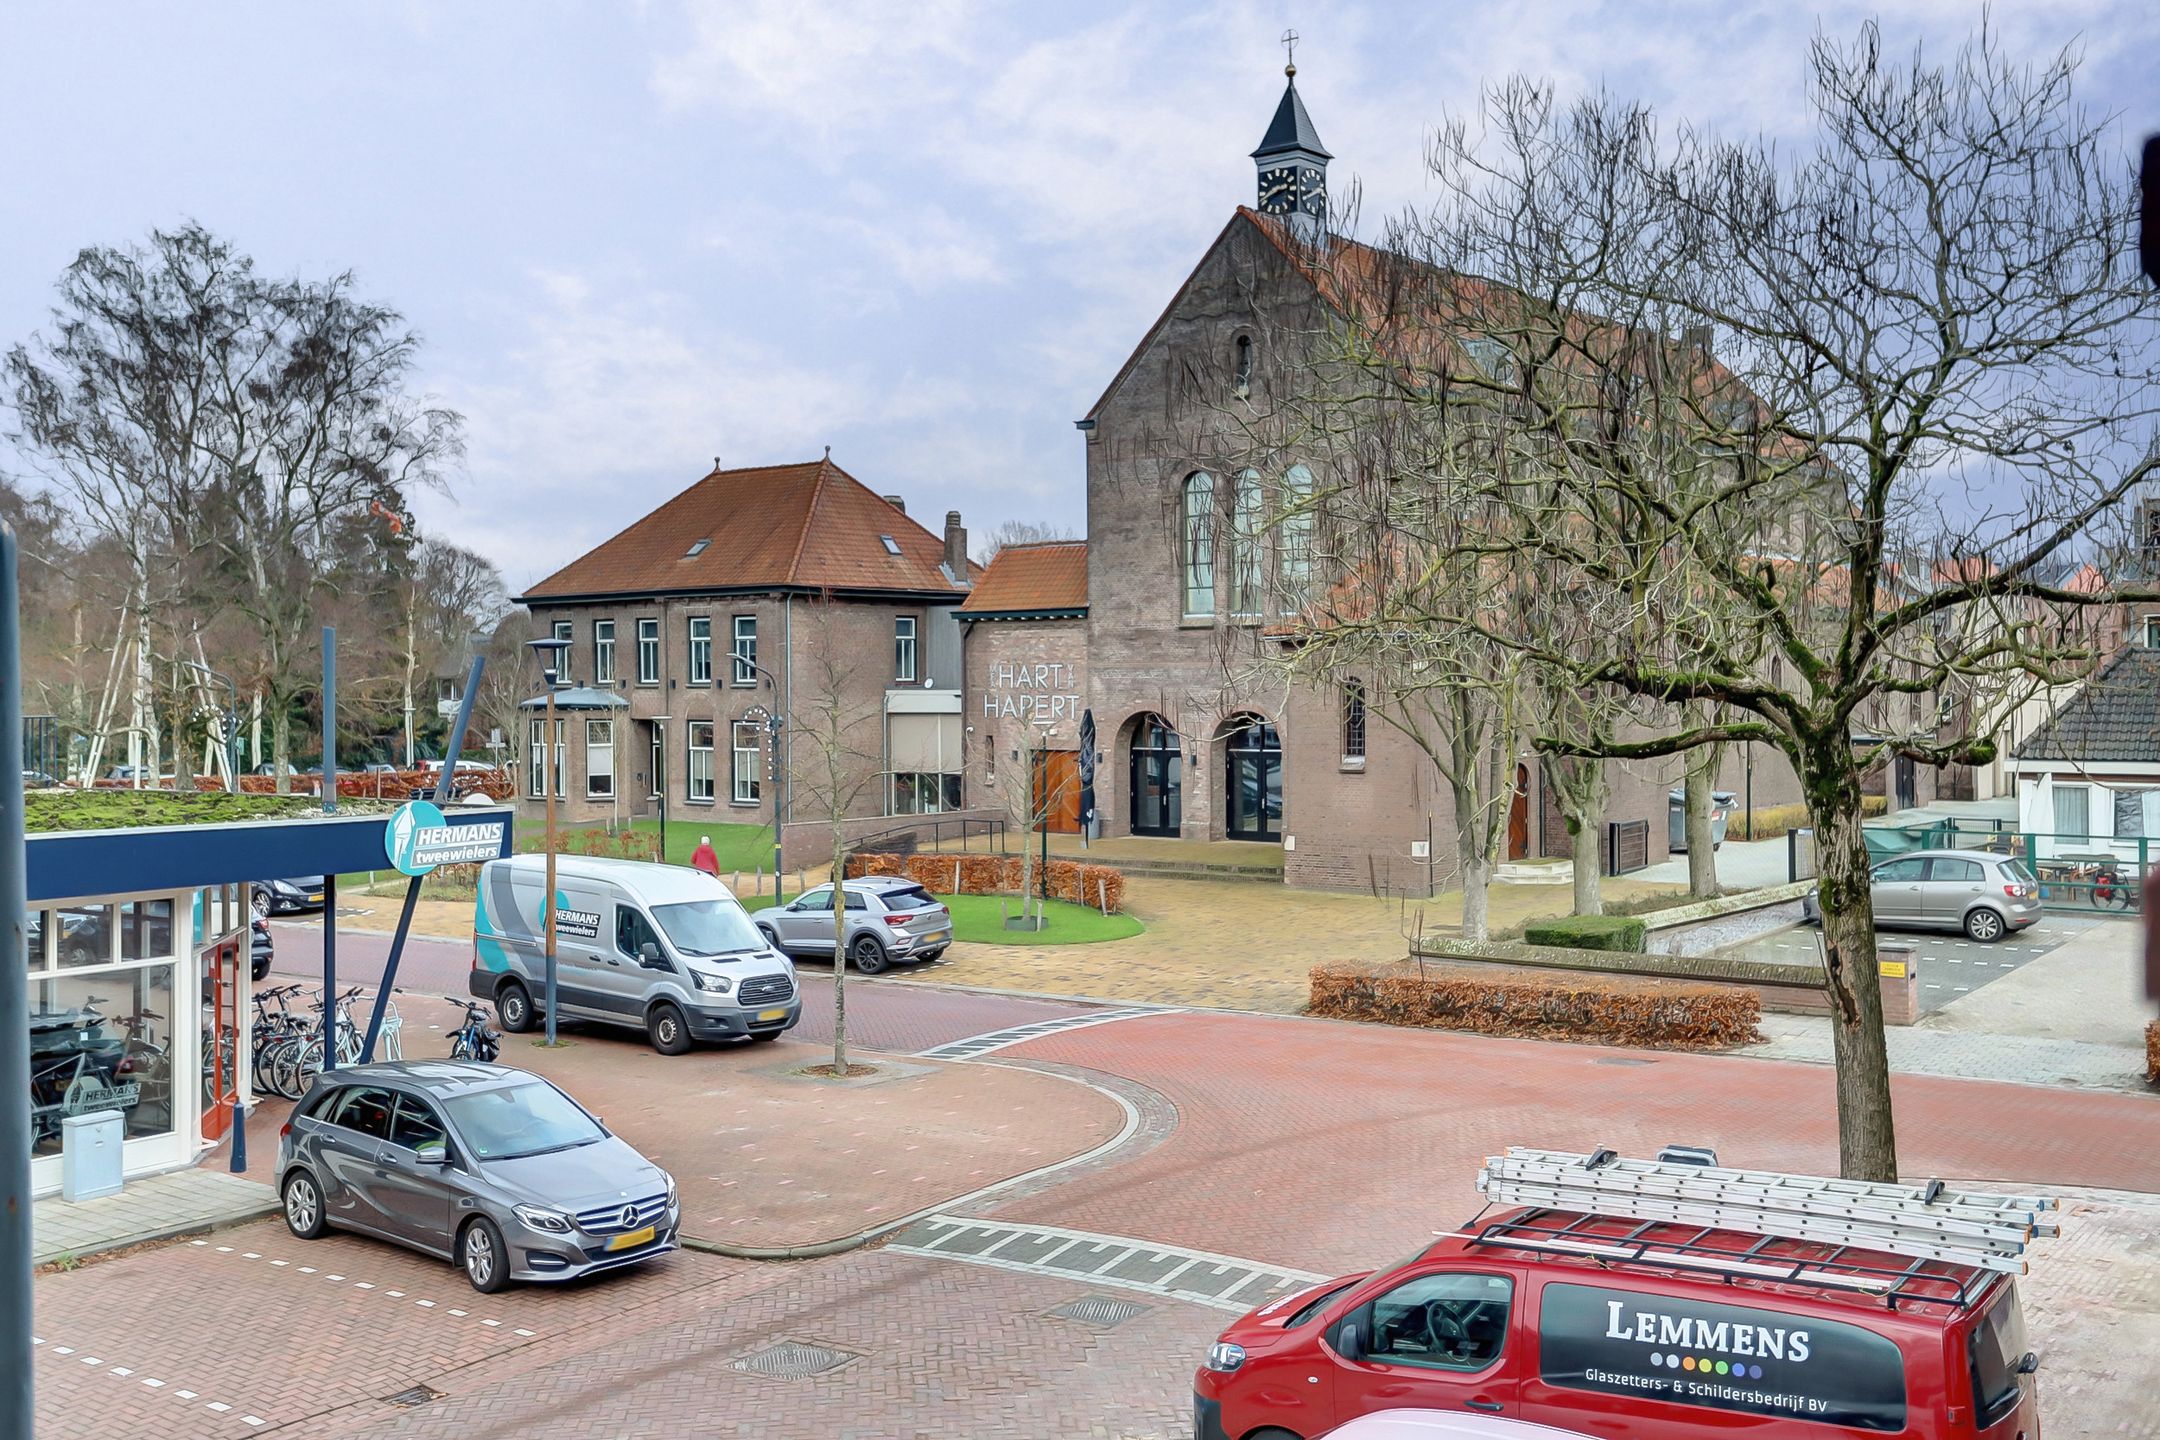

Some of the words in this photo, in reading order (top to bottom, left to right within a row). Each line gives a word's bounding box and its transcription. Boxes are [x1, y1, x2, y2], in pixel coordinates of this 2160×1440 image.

[999, 664, 1063, 689] HART
[984, 694, 1079, 719] HAPERT
[418, 823, 502, 845] HERMANS
[416, 845, 498, 864] tweewielers
[555, 924, 596, 937] weewielers
[1605, 1300, 1810, 1363] LEMMENS
[1585, 1368, 1669, 1390] Glaszetters-
[1673, 1380, 1683, 1393] &
[1688, 1382, 1804, 1412] Schildersbedrijf
[1808, 1399, 1828, 1413] BV
